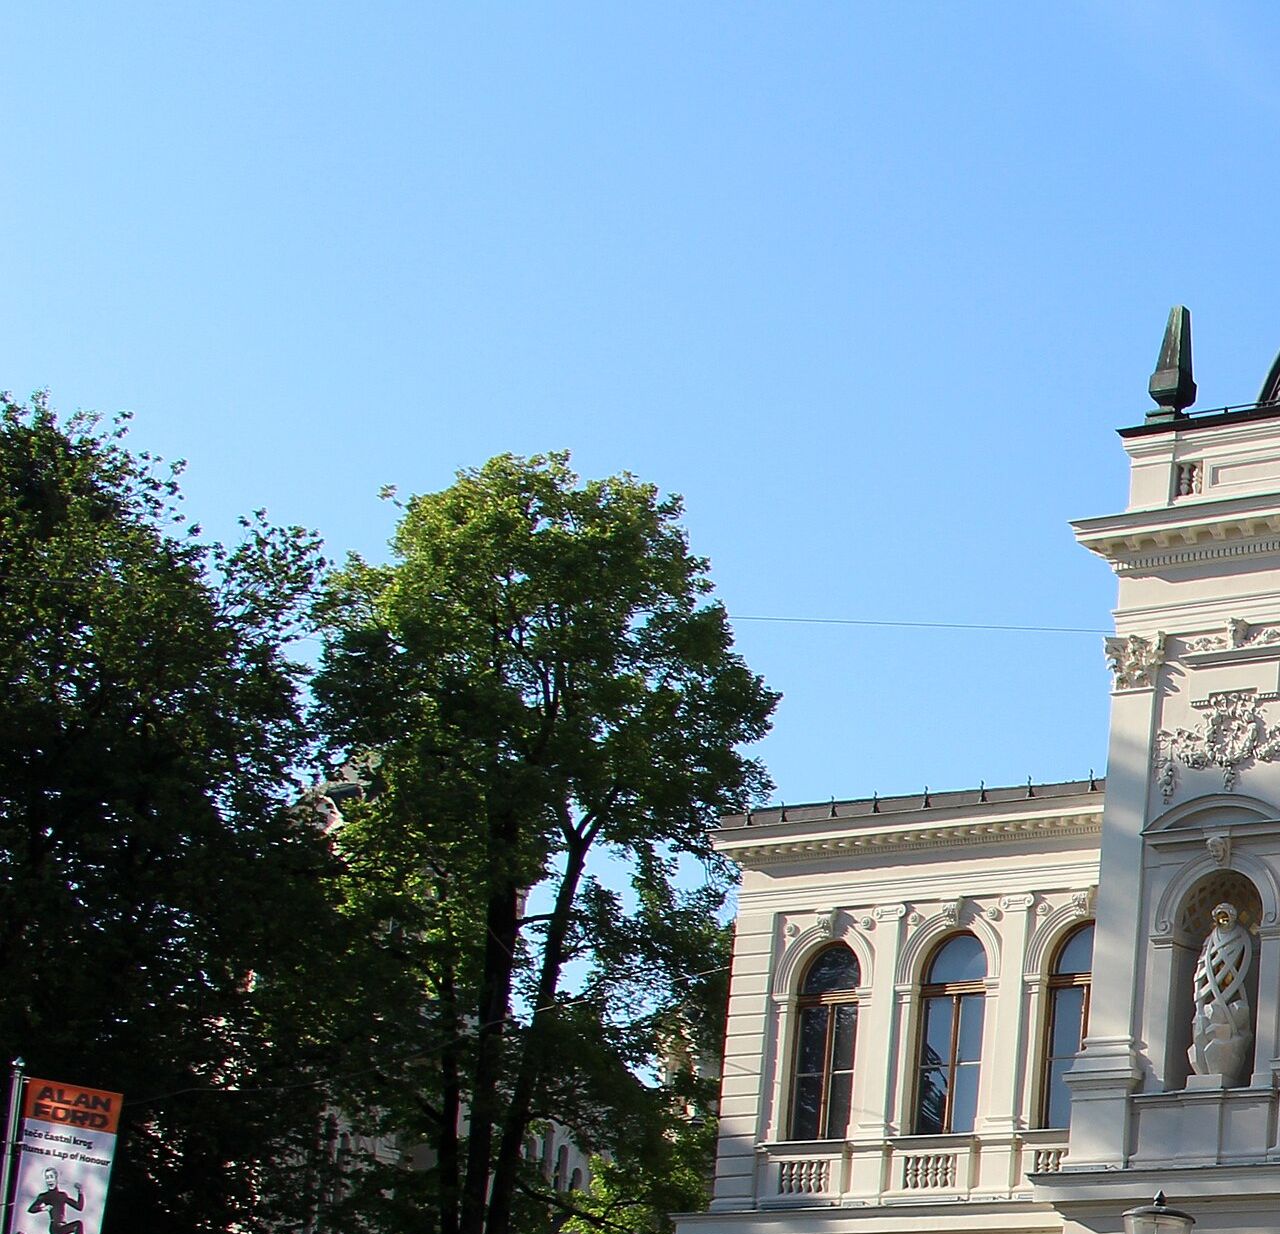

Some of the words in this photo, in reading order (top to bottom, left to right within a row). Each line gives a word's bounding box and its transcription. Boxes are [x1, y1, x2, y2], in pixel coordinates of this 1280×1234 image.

[37, 1086, 113, 1113] ALAN
[33, 1102, 110, 1129] FORD
[24, 1128, 44, 1139] teče
[44, 1131, 72, 1144] častni
[73, 1136, 94, 1150] krog
[52, 1148, 68, 1161] Lap
[70, 1152, 79, 1160] of
[79, 1154, 111, 1167] Honour
